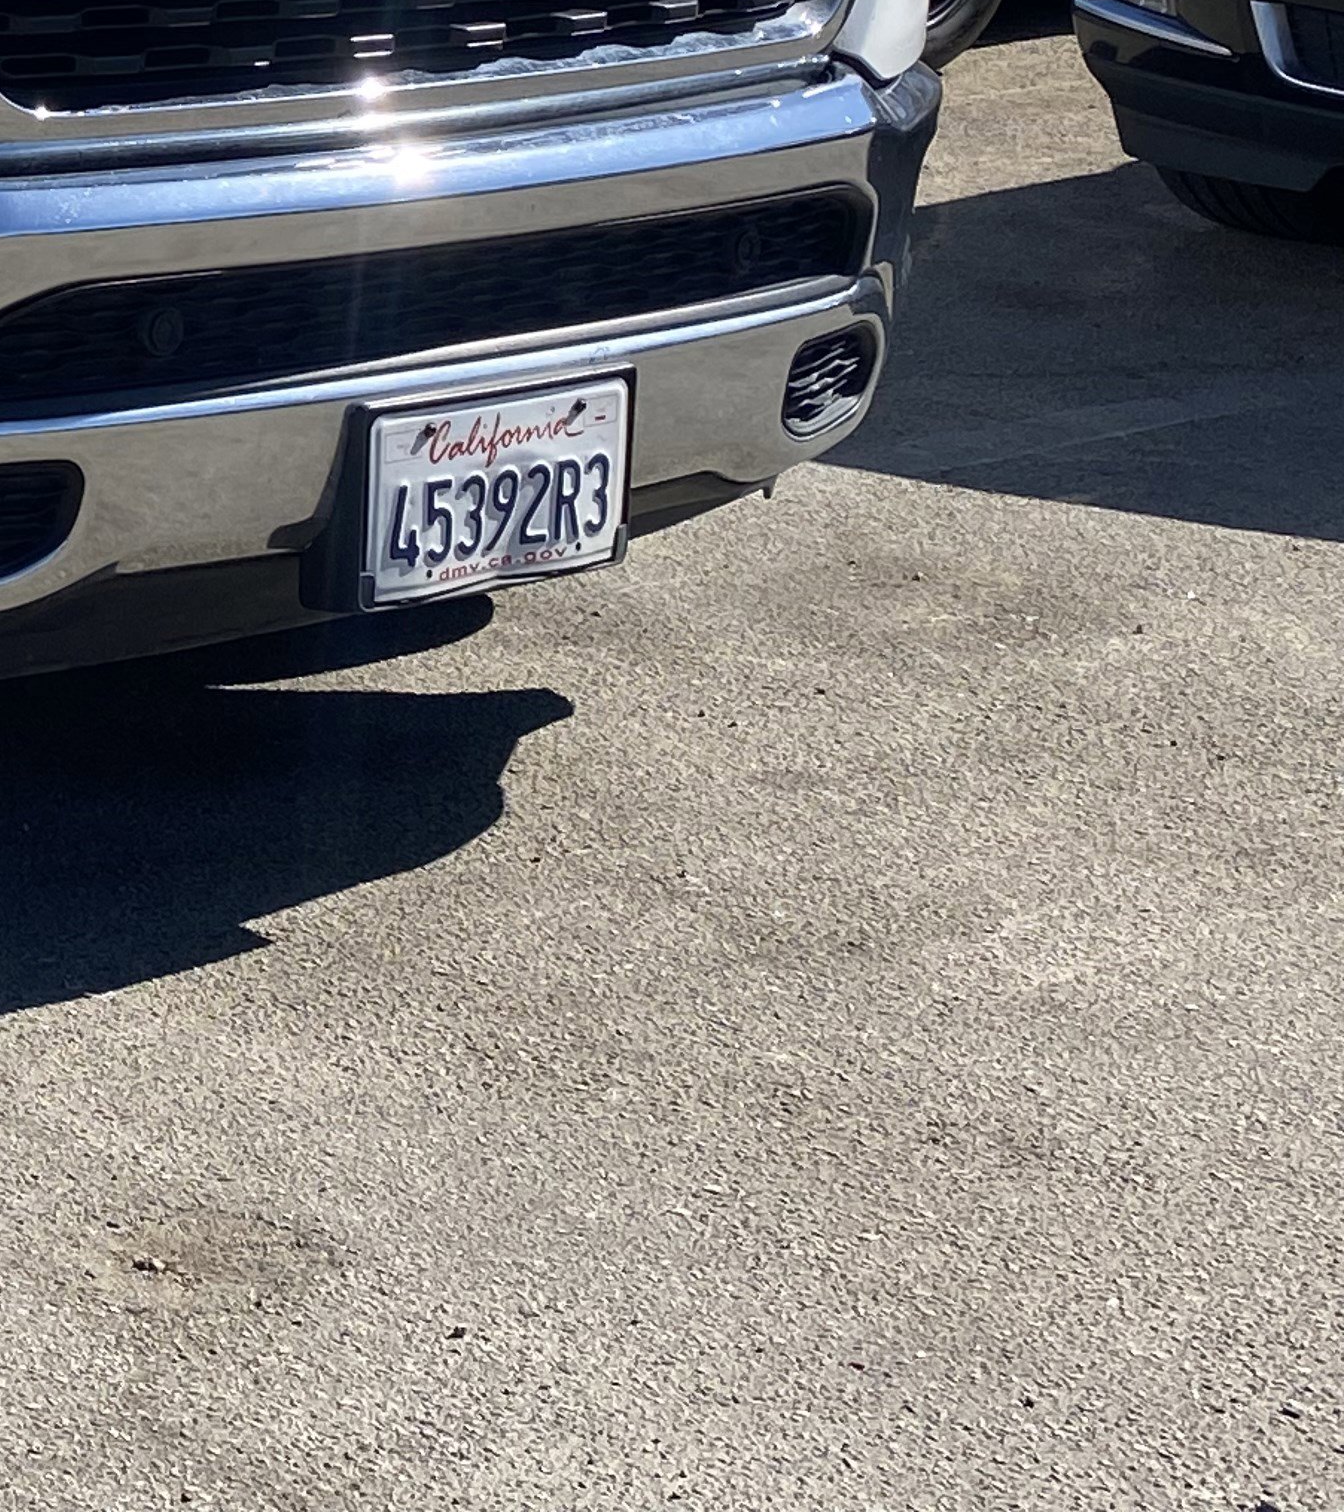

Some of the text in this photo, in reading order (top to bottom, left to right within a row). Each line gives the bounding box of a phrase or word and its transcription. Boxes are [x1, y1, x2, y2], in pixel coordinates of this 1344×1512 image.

[428, 412, 584, 468] California
[391, 452, 610, 567] 45392R3
[438, 545, 568, 582] dmv.ca.gov
